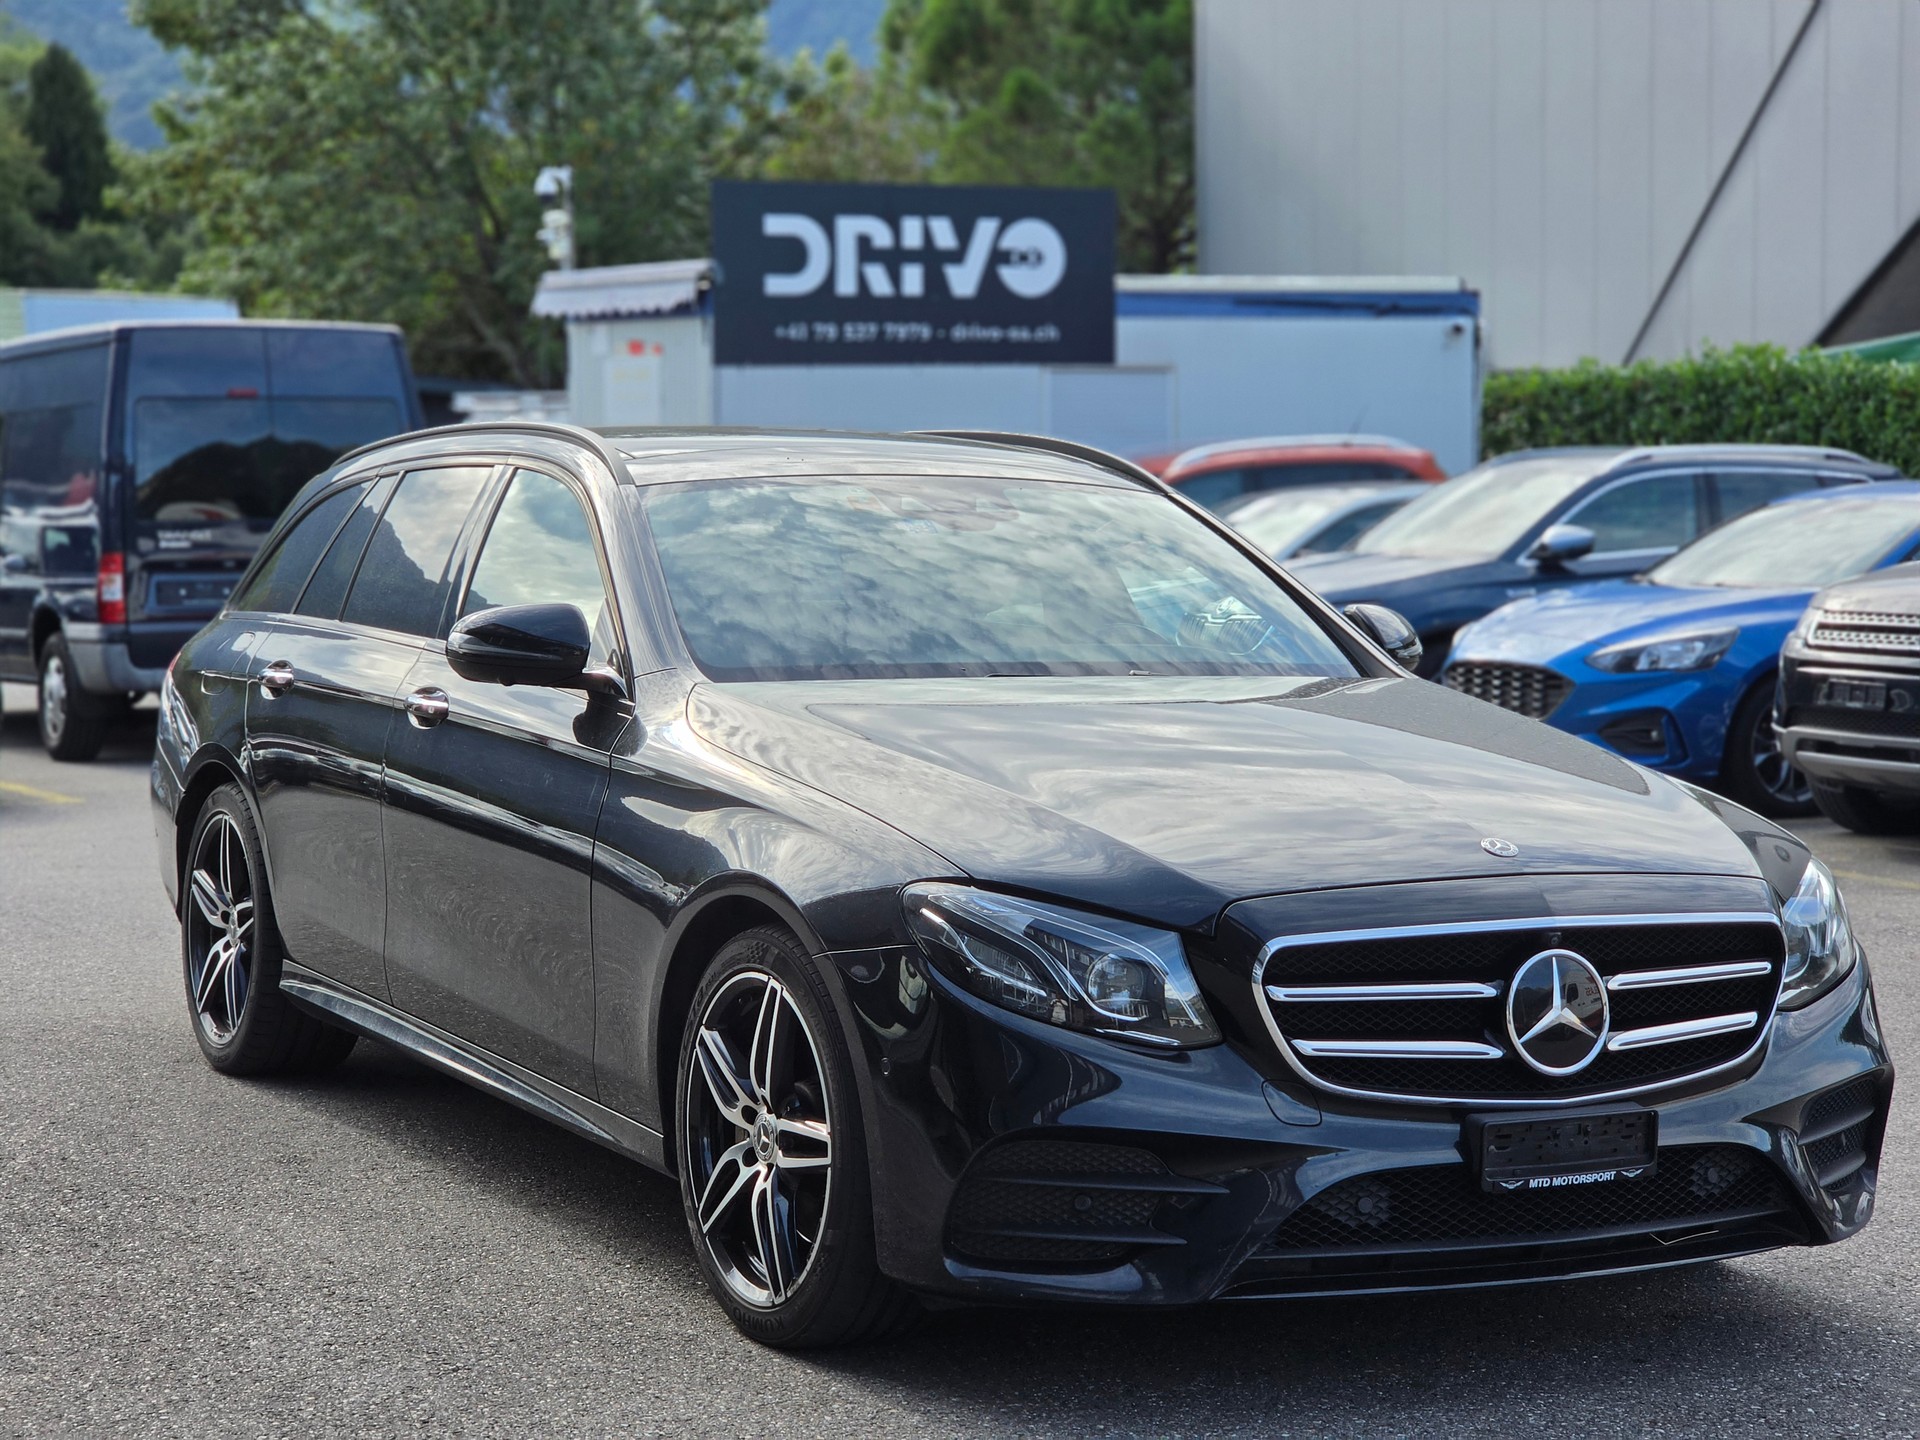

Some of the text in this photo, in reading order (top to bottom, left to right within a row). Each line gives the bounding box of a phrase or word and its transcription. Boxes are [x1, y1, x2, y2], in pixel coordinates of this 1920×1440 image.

[762, 213, 1068, 299] DRIVO
[1529, 1171, 1617, 1188] MTD MOTORSPORT
[732, 1306, 784, 1333] KUMHO
